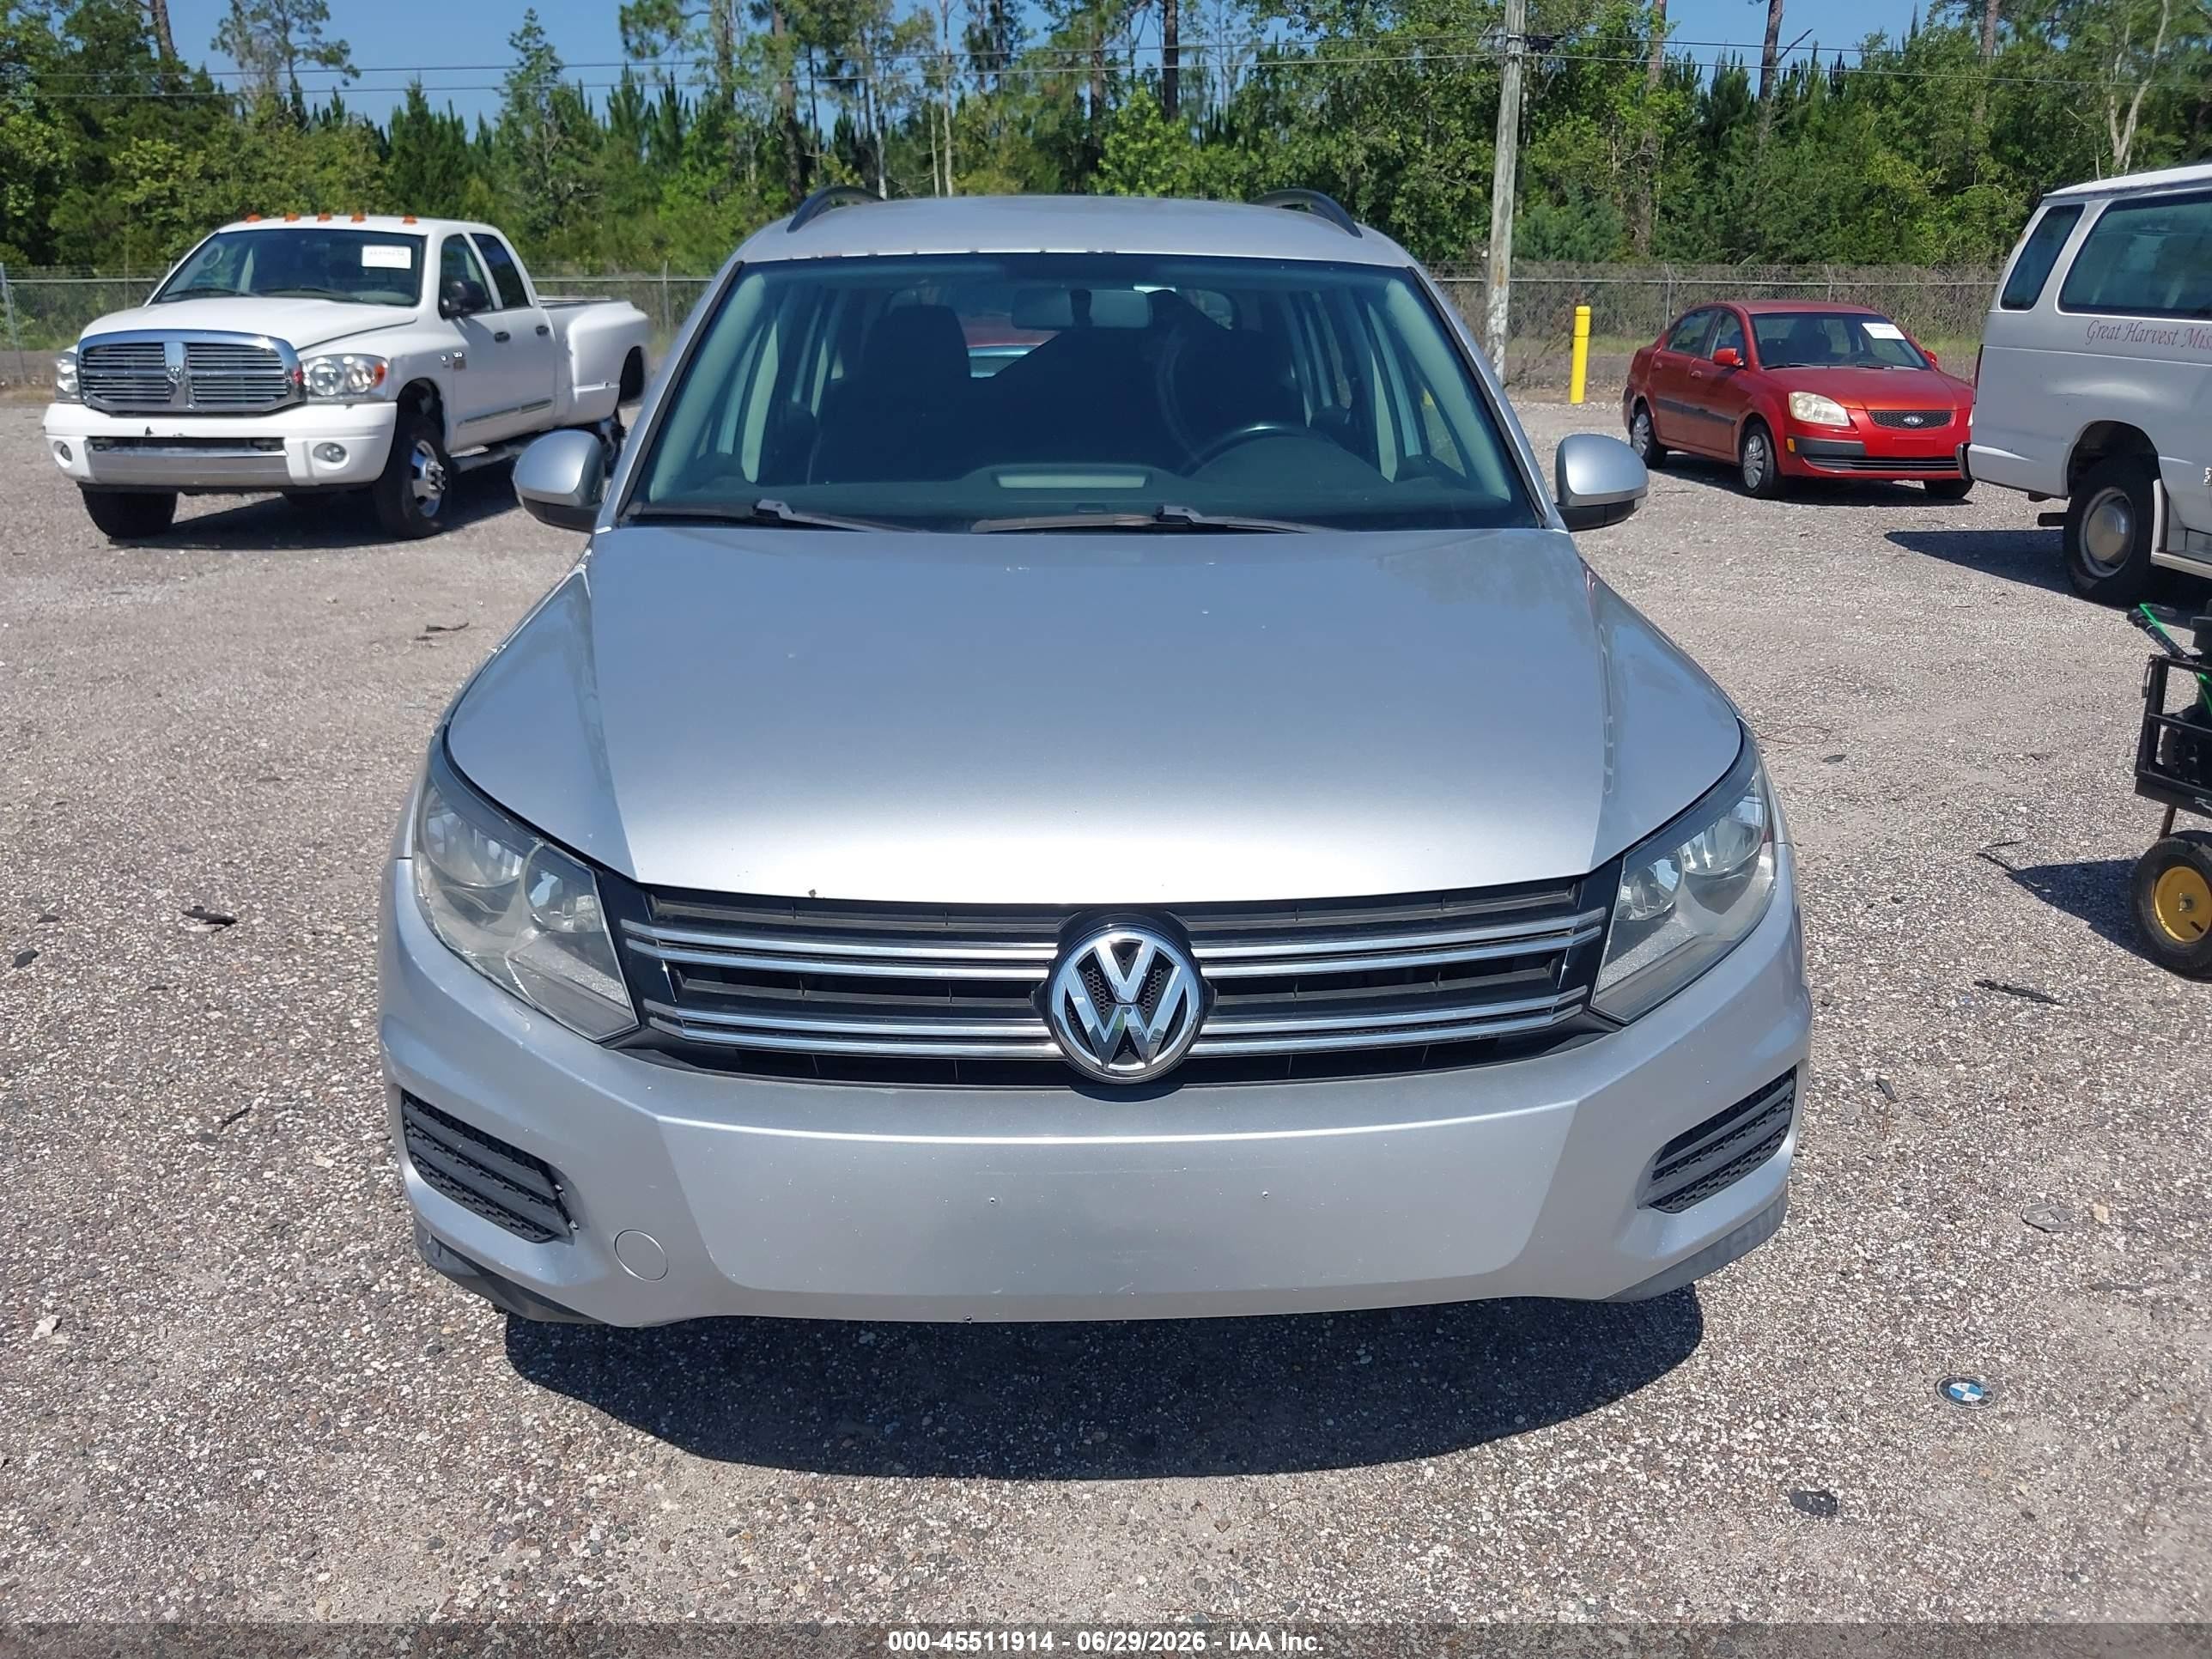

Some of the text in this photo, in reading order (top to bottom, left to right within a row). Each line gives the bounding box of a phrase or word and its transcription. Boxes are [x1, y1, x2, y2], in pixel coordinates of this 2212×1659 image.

[2085, 319, 2122, 345] Great
[2124, 321, 2179, 346] Harvest
[1052, 925, 1200, 1080] VW
